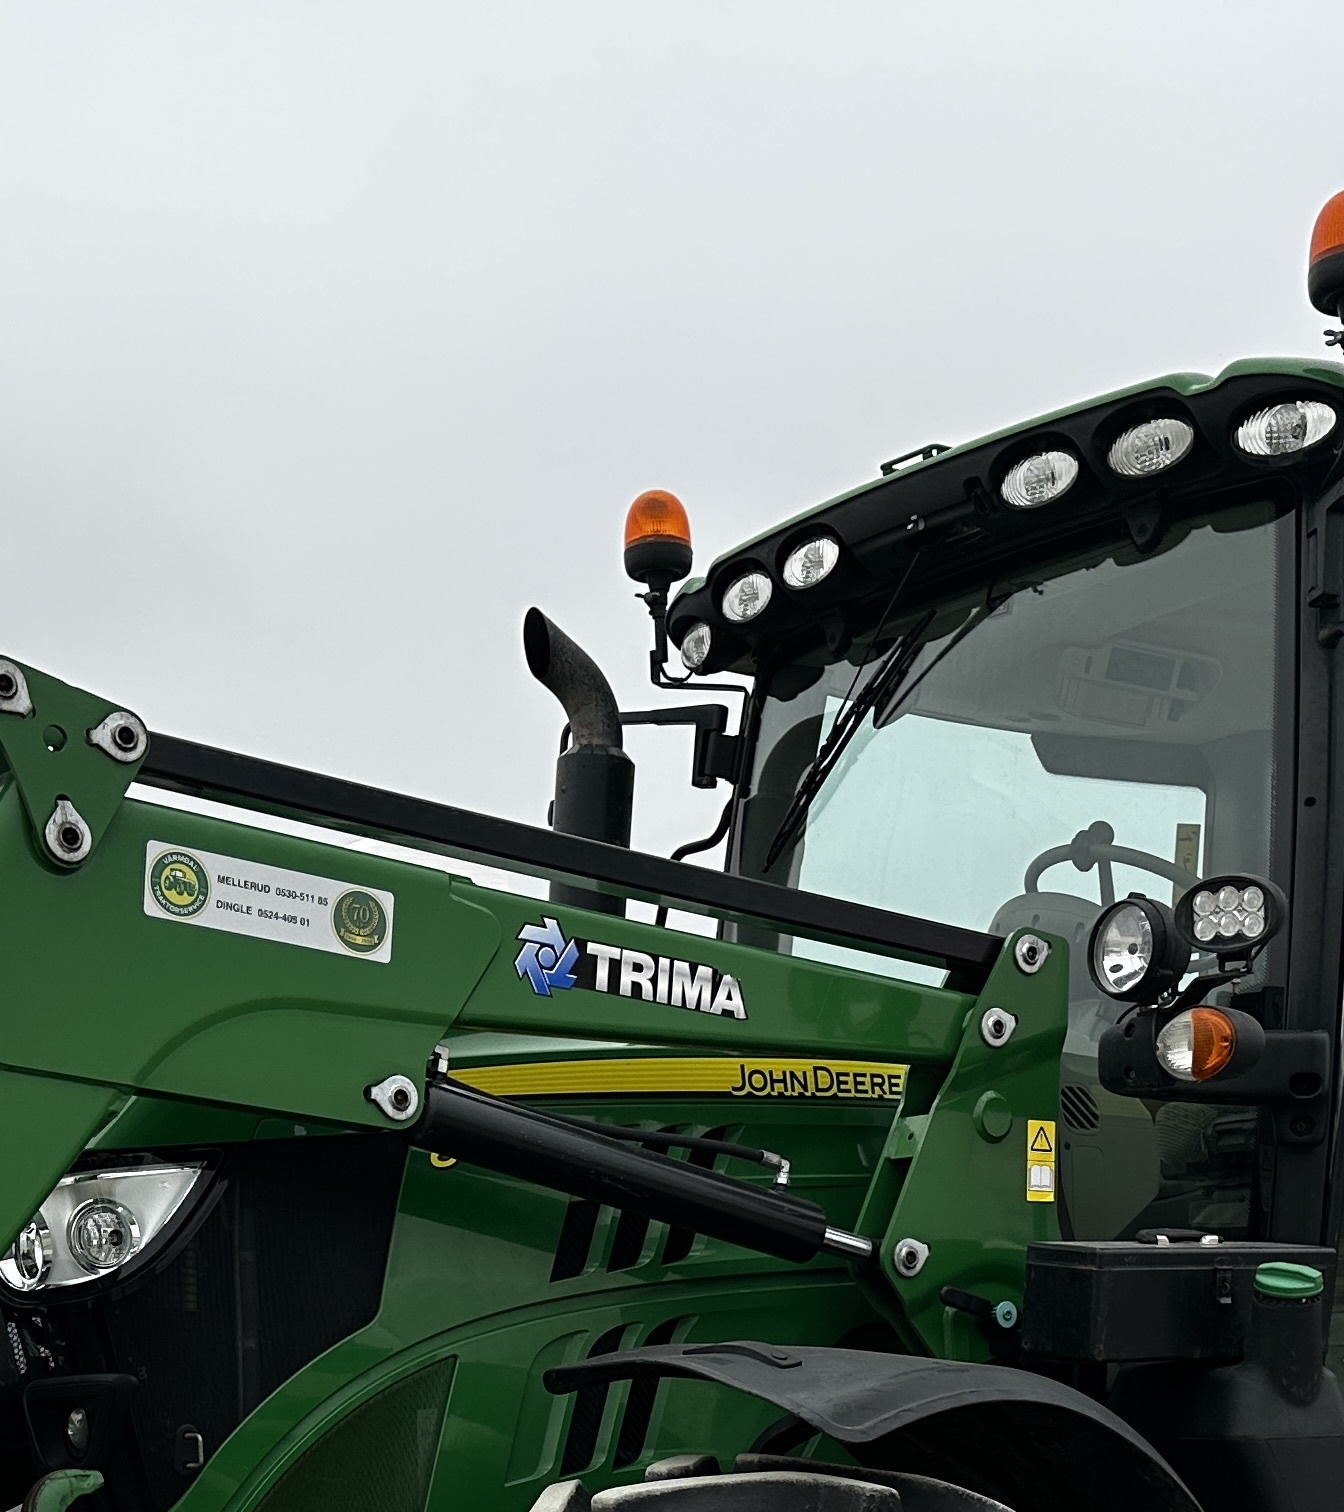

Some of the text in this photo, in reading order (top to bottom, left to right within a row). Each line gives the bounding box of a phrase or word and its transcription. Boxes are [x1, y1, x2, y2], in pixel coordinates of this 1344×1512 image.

[217, 874, 271, 894] MELLERUD
[216, 899, 253, 915] DINGLE
[299, 917, 310, 927] 01
[352, 903, 370, 923] 70
[586, 941, 748, 1020] TRIMA
[731, 1064, 903, 1098] JOHN DEERE
